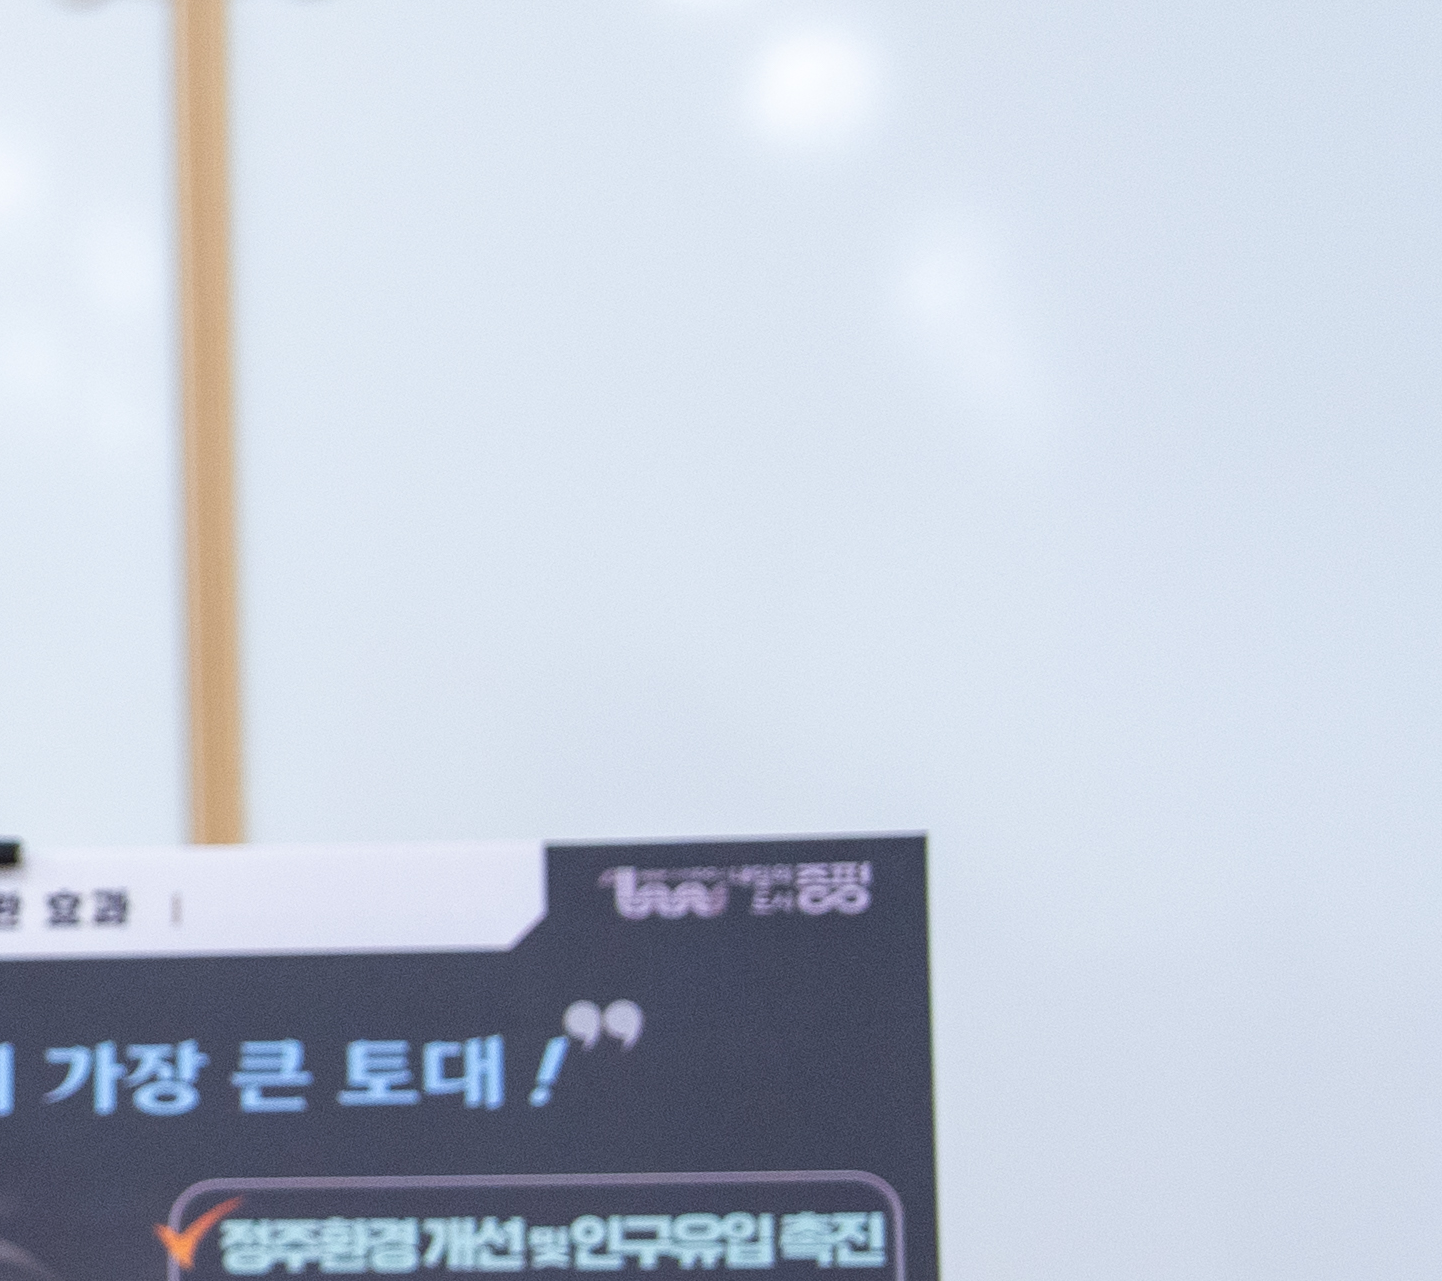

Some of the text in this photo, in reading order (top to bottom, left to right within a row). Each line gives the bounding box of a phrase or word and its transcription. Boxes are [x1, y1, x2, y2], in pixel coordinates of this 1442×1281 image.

[45, 888, 130, 930] 효과
[43, 1037, 211, 1118] 가장
[232, 1038, 313, 1113] 큰
[220, 1210, 887, 1275] 정주환경 개선 및 인구유입 촉진
